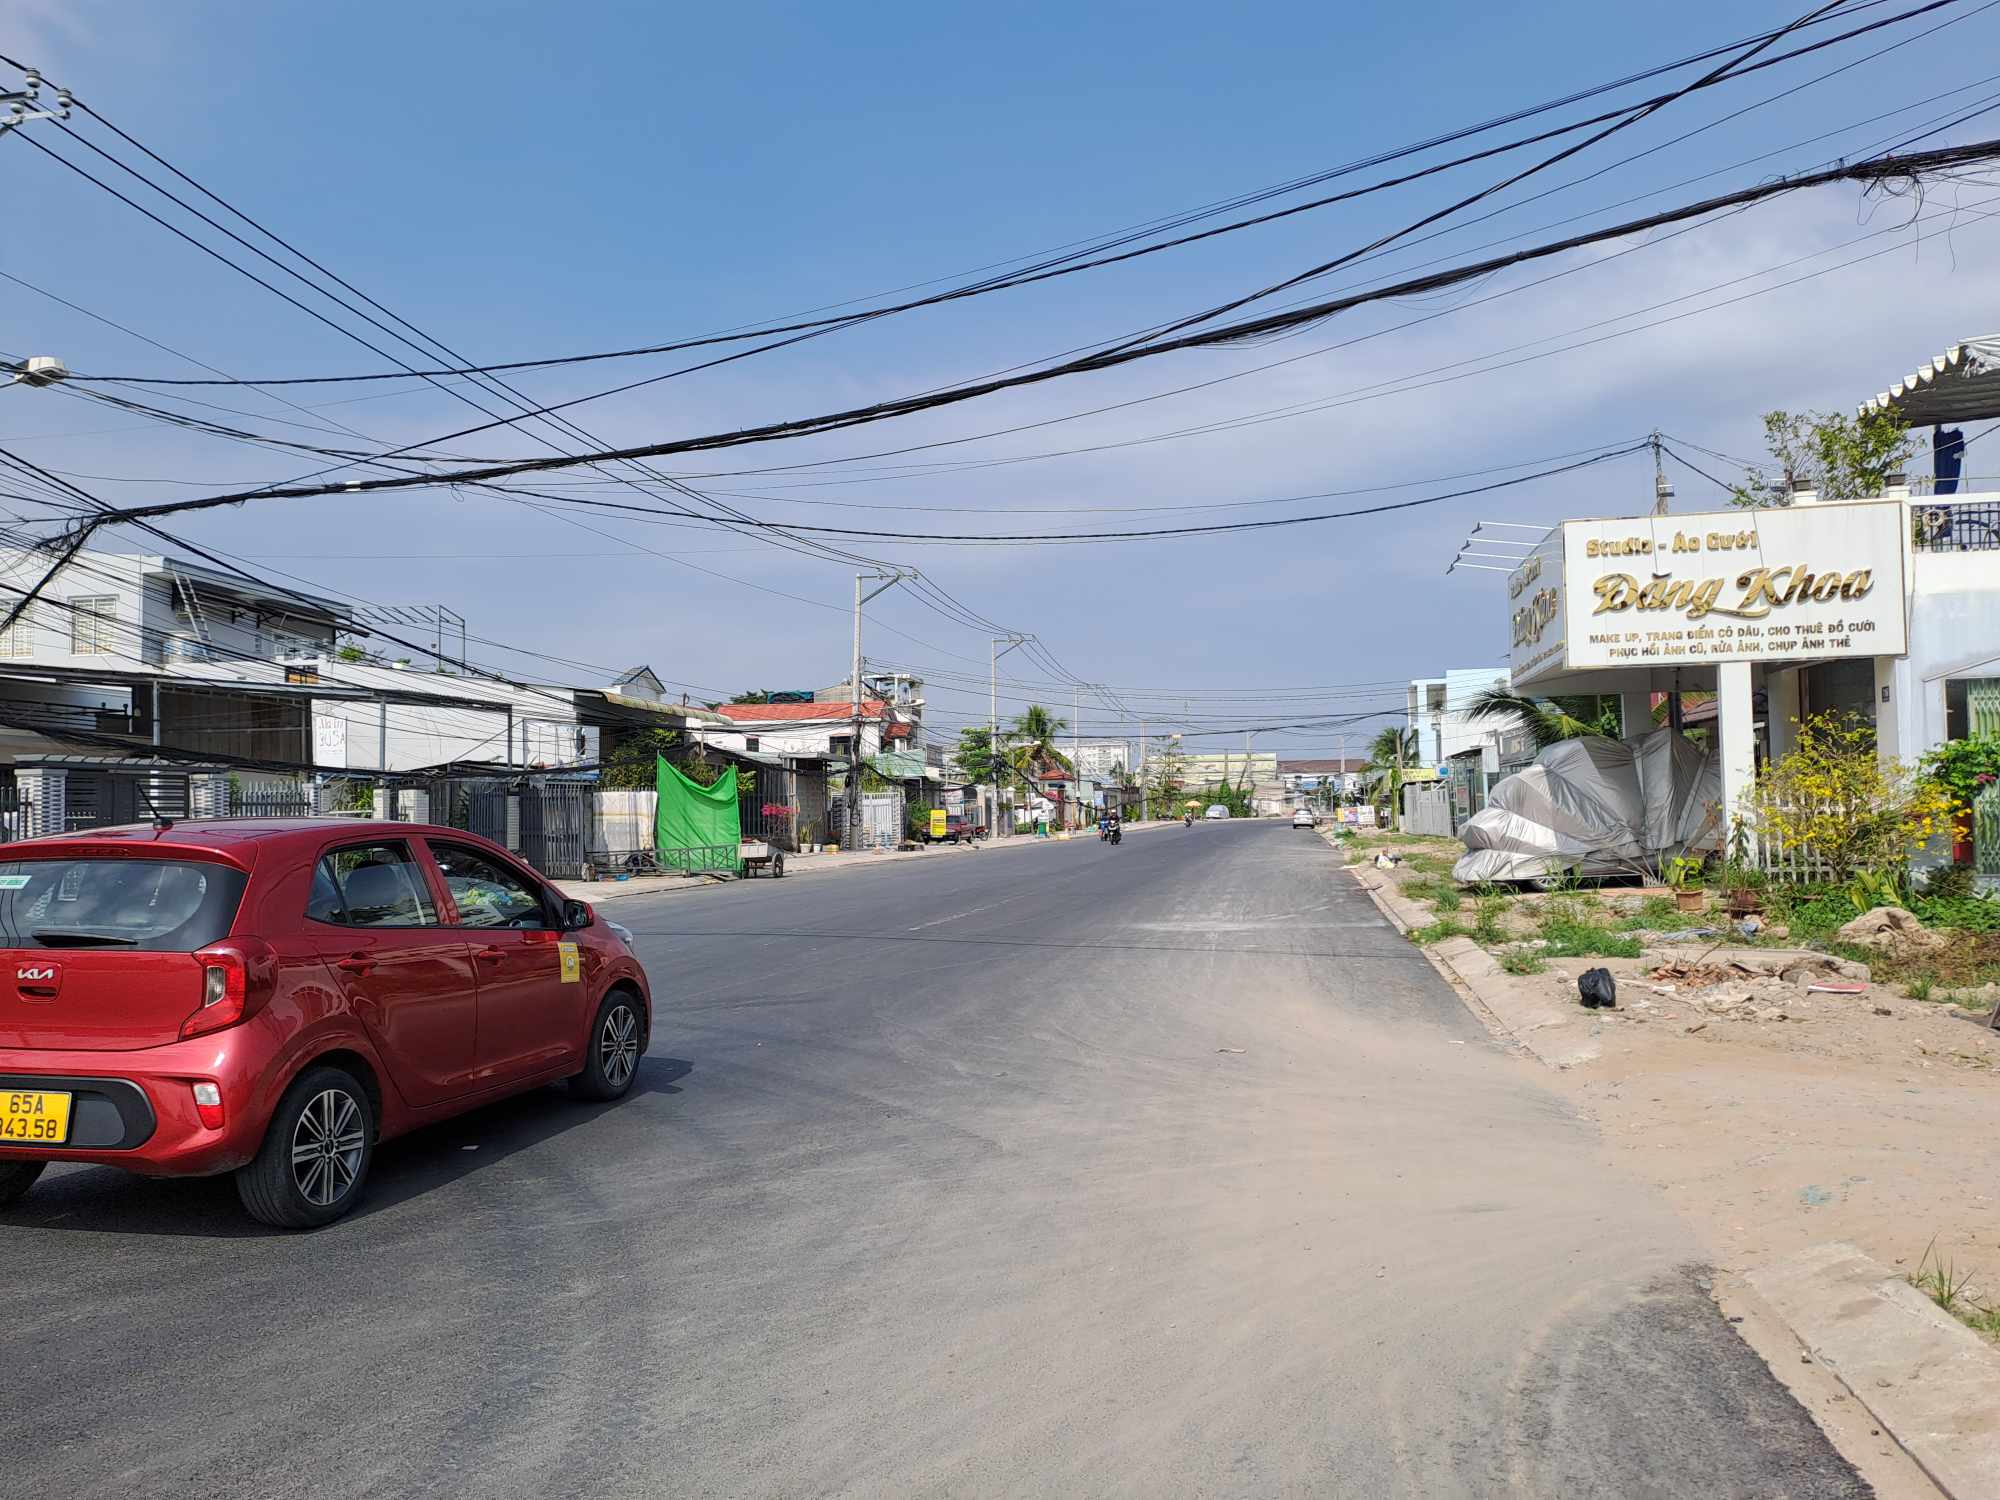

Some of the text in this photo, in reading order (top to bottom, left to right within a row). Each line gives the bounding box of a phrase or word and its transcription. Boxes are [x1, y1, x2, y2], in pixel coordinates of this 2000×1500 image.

[1586, 537, 1653, 557] Studio
[1672, 530, 1700, 553] Áo
[1592, 571, 1771, 620] Đăng
[1736, 563, 1875, 610] Khoa
[1589, 633, 1621, 644] MAKE
[1624, 632, 1643, 643] UP,
[1645, 631, 1683, 641] TRANG
[1718, 626, 1733, 638] CÔ
[1768, 626, 1790, 636] CHO
[1795, 622, 1823, 635] THUÊ
[1609, 647, 1638, 659] PHỤC
[1663, 643, 1686, 655] ẢNH
[1768, 640, 1798, 652] CHỤP
[1801, 636, 1824, 650] ẢNH
[10, 1094, 44, 1114] 65A
